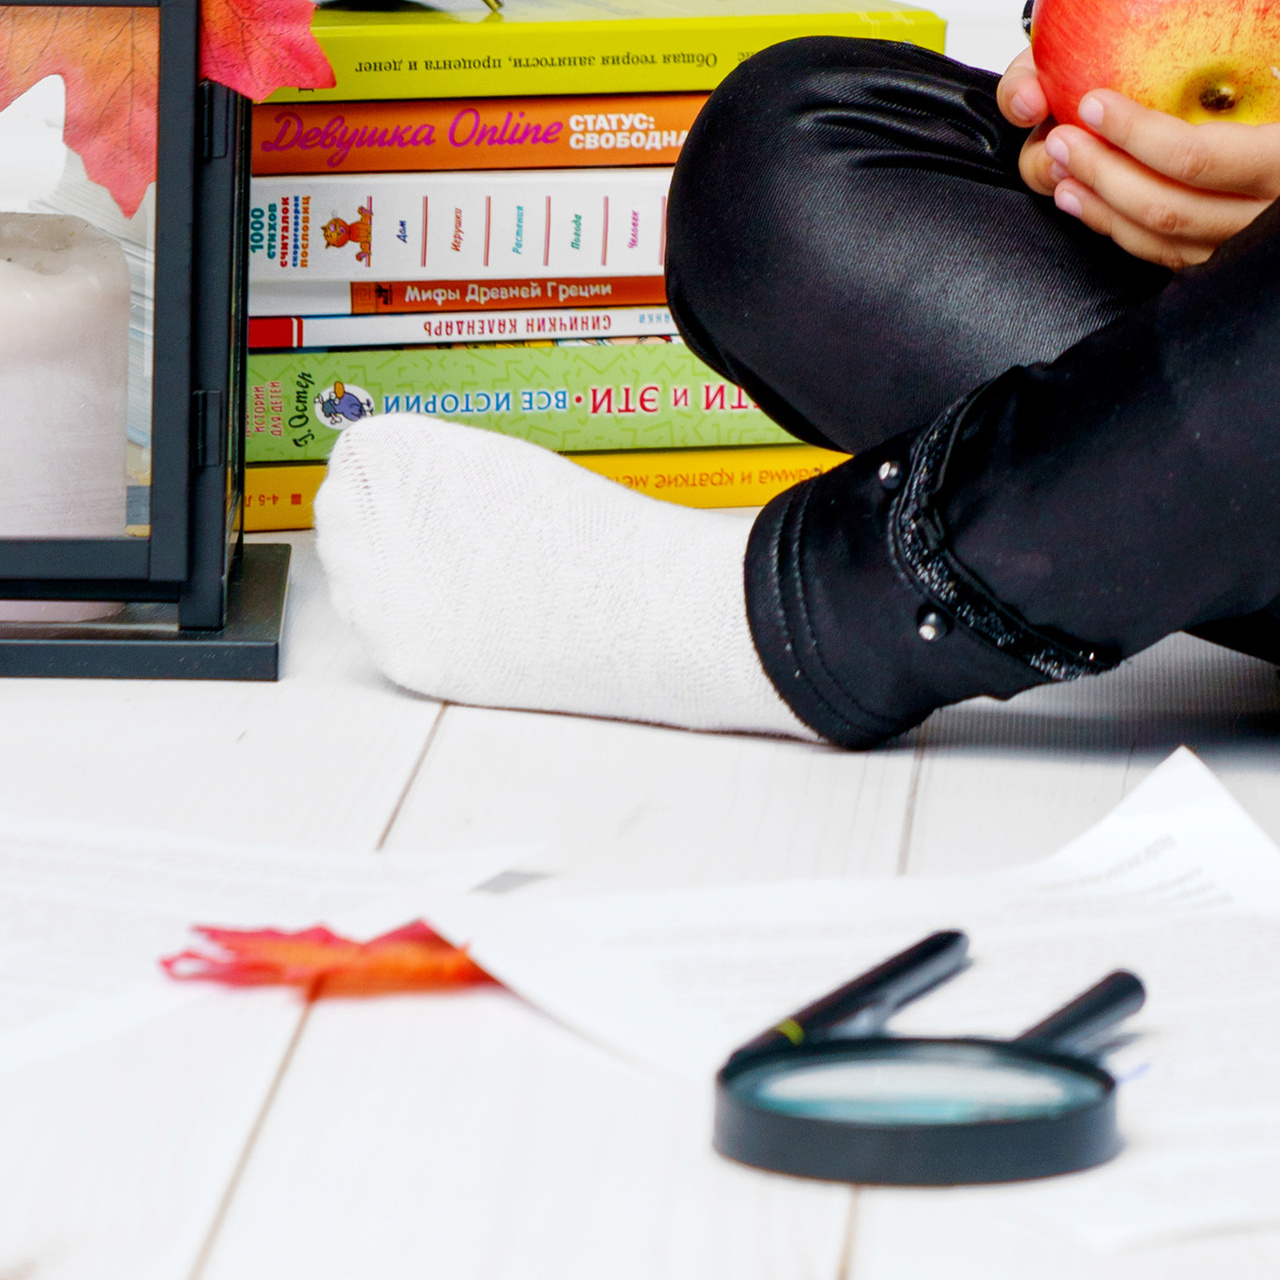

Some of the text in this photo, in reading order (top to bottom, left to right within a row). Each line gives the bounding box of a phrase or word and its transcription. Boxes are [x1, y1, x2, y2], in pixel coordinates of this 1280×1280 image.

[355, 58, 404, 73] денег
[408, 61, 418, 71] и
[425, 55, 502, 72] процента
[508, 55, 596, 70] занятости,
[601, 51, 657, 67] теория
[662, 51, 718, 68] Общая
[569, 113, 655, 131] СТАТУС:
[261, 107, 564, 168] Девушка Online
[250, 207, 265, 253] 1000
[267, 202, 277, 260] стихов
[280, 196, 290, 268] считалок
[292, 195, 300, 268] скороговорок
[300, 195, 312, 268] пословиц
[396, 220, 407, 244] Дом
[450, 207, 463, 252] Игрушки
[512, 205, 524, 255] Растения
[570, 213, 582, 250] Погода
[627, 209, 640, 249] Человек
[404, 281, 612, 306] Мифы Древней Греции
[424, 317, 517, 338] КАЛЕНДАРЬ
[526, 313, 612, 334] СИНИЧКИН
[253, 385, 266, 433] ИСТОРИИ
[267, 381, 283, 437] ДЛЯ ДЕТЕЙ
[288, 371, 315, 428] Остер
[384, 391, 512, 414] ИСТОРИИ
[521, 390, 568, 412] ВСЕ
[590, 385, 661, 414] ЭТИ
[654, 467, 735, 489] краткие
[740, 472, 752, 484] и
[258, 493, 279, 507] 4-5
